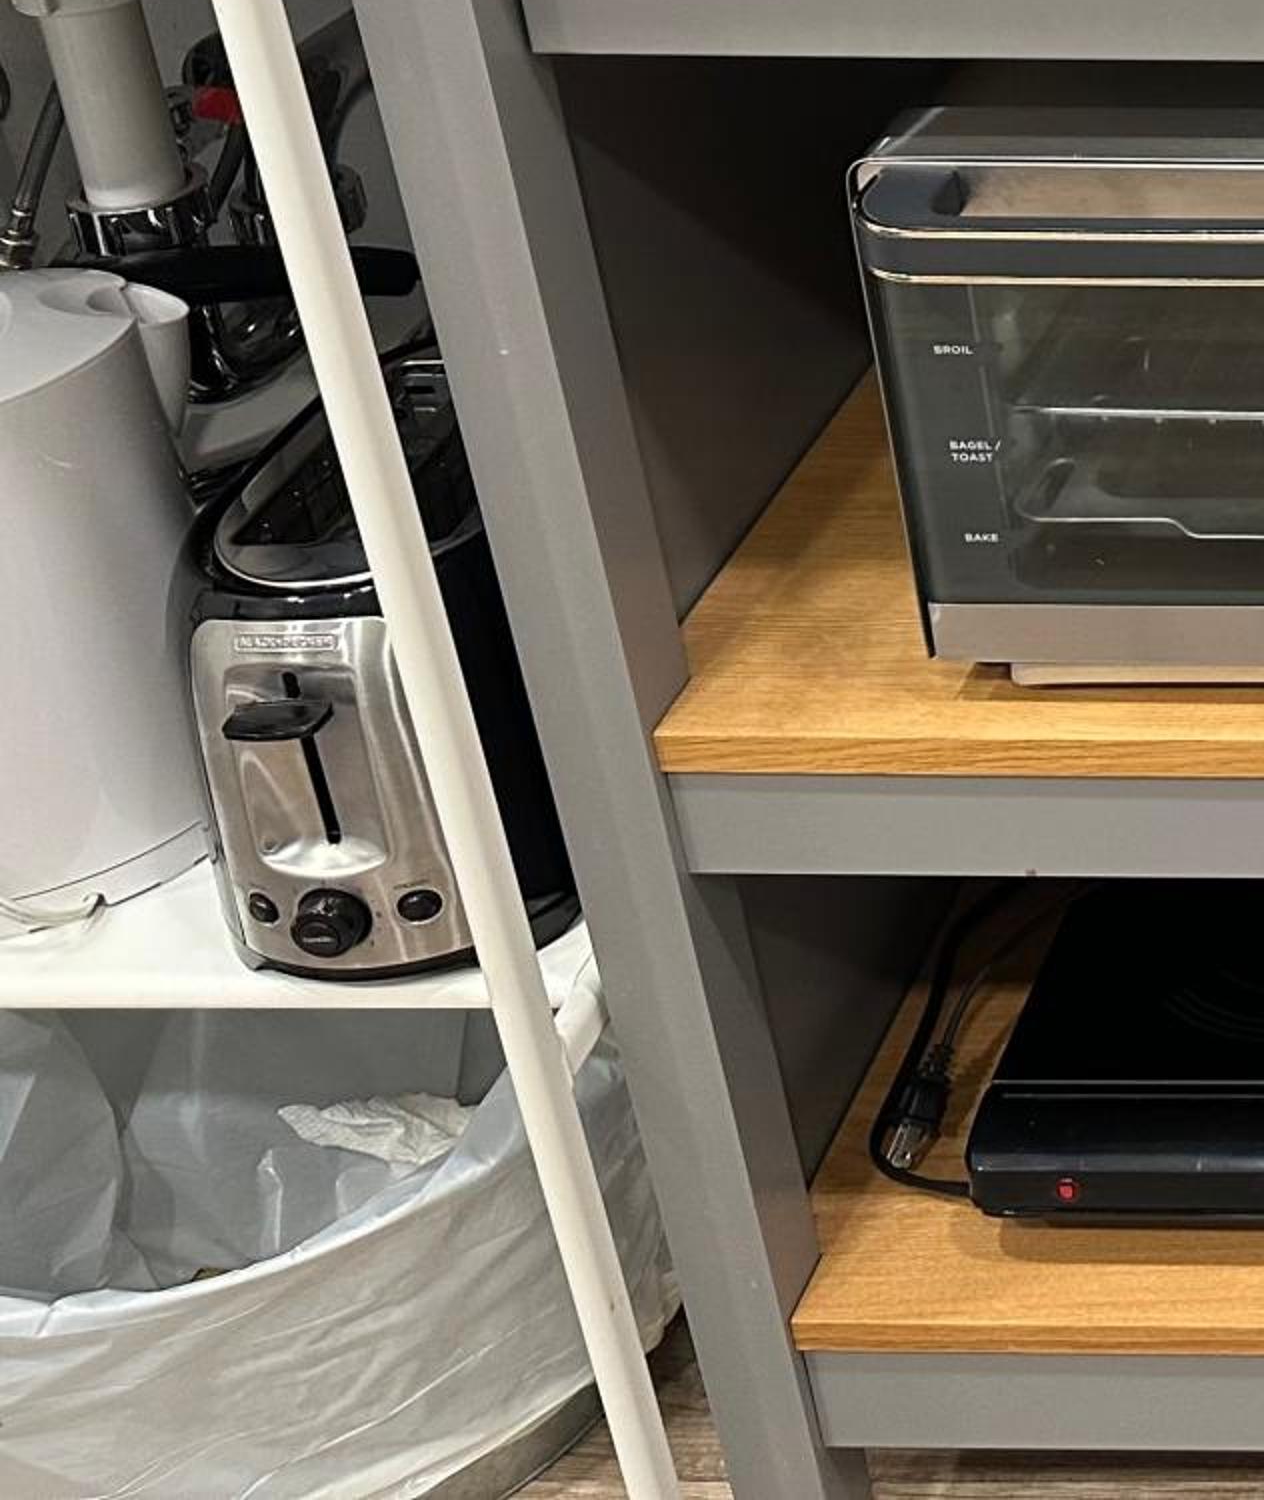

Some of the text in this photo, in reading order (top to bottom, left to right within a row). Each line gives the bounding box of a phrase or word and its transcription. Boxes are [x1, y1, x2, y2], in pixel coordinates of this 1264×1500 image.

[933, 345, 974, 355] BROIL
[951, 453, 993, 462] TOAST
[964, 533, 999, 543] BAKE
